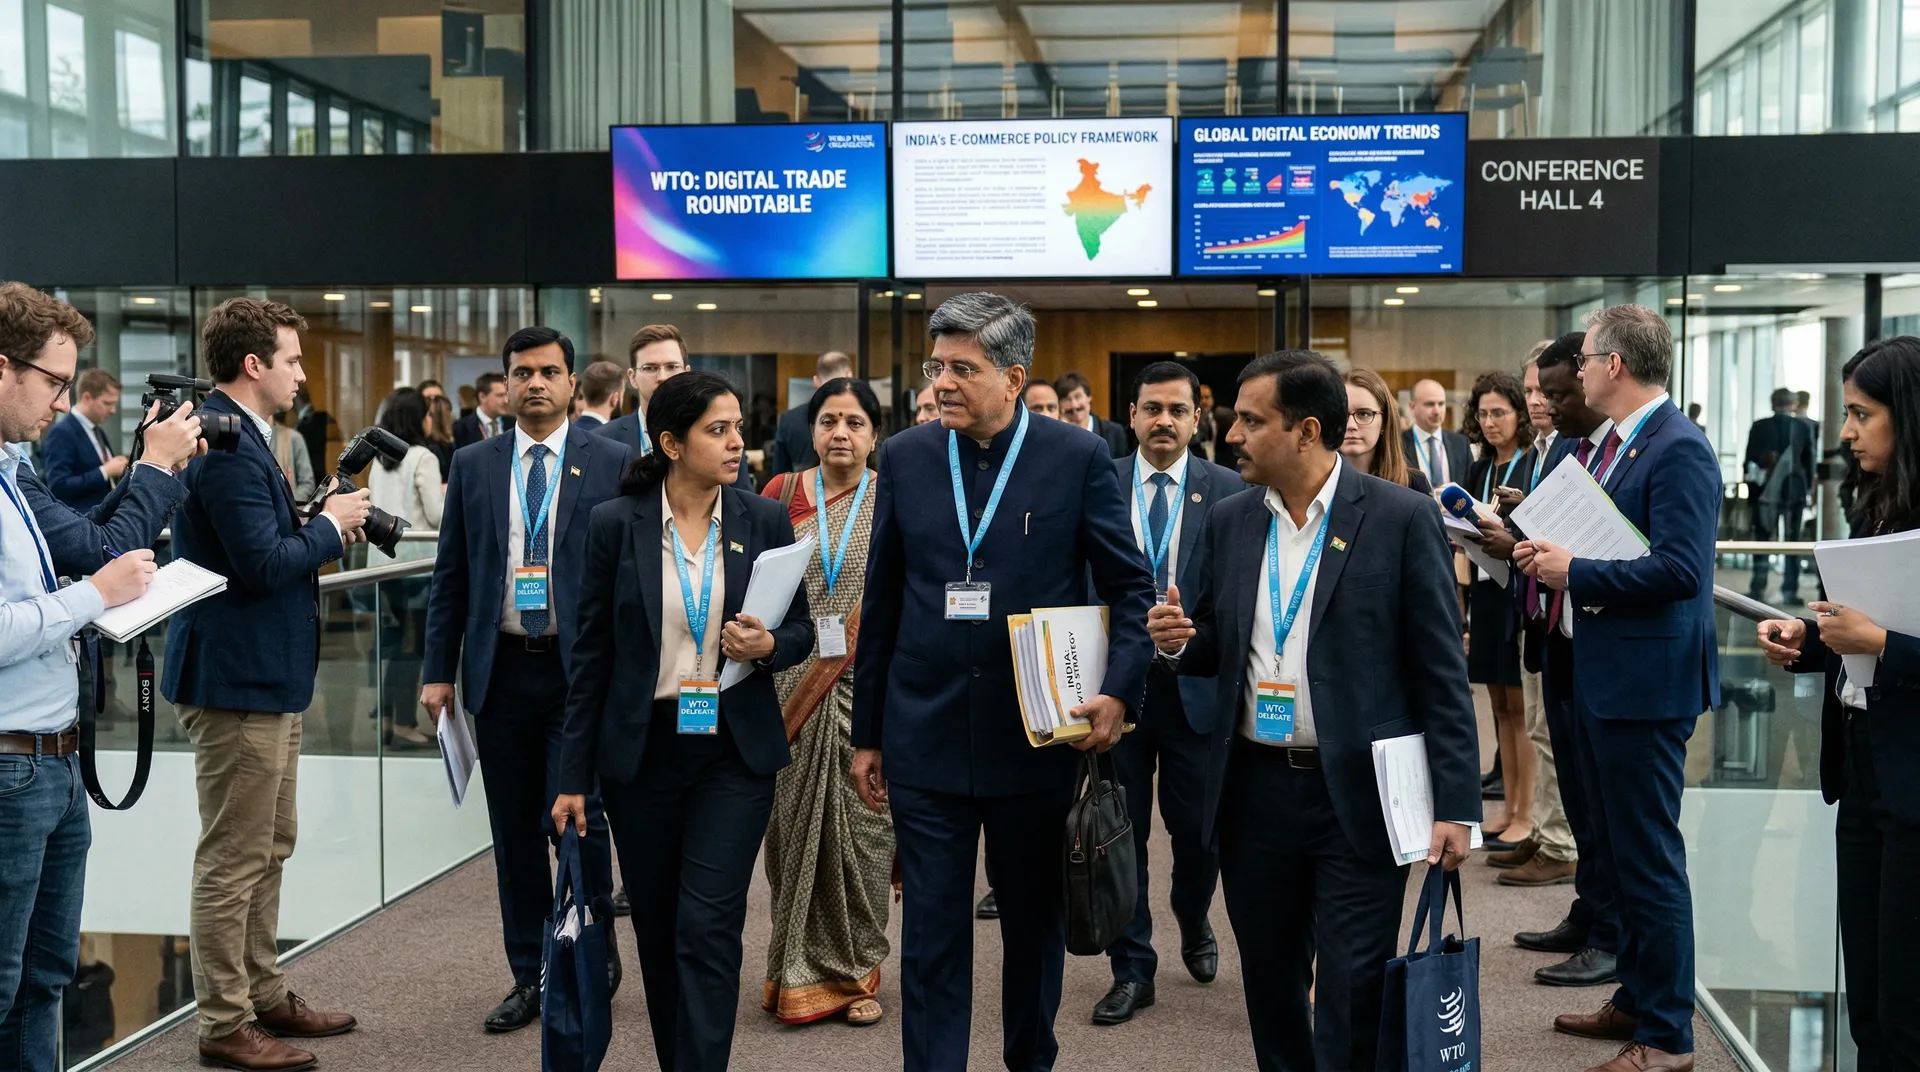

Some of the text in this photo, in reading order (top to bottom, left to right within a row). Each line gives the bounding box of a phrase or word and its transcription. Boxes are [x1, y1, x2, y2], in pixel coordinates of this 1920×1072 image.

[905, 130, 1159, 147] INDIA's E-COMMERCE POLICY FRAMEWORK
[1194, 124, 1440, 143] GLOBAL DIGITAL ECONOMY TRENDS
[651, 169, 847, 191] WTO: DIGITAL TRADE
[1481, 158, 1644, 182] CONFERENCE
[686, 194, 812, 215] ROUNDTABLE
[1520, 188, 1604, 210] HALL 4
[521, 582, 540, 590] WTO
[1068, 631, 1081, 680] STRATEGY
[1064, 650, 1075, 689] INDIA:
[141, 679, 150, 713] SONY
[688, 700, 709, 708] WTO
[1257, 712, 1292, 722] DELEGATE
[1264, 703, 1286, 714] WTO
[1440, 1041, 1466, 1063] WTO
